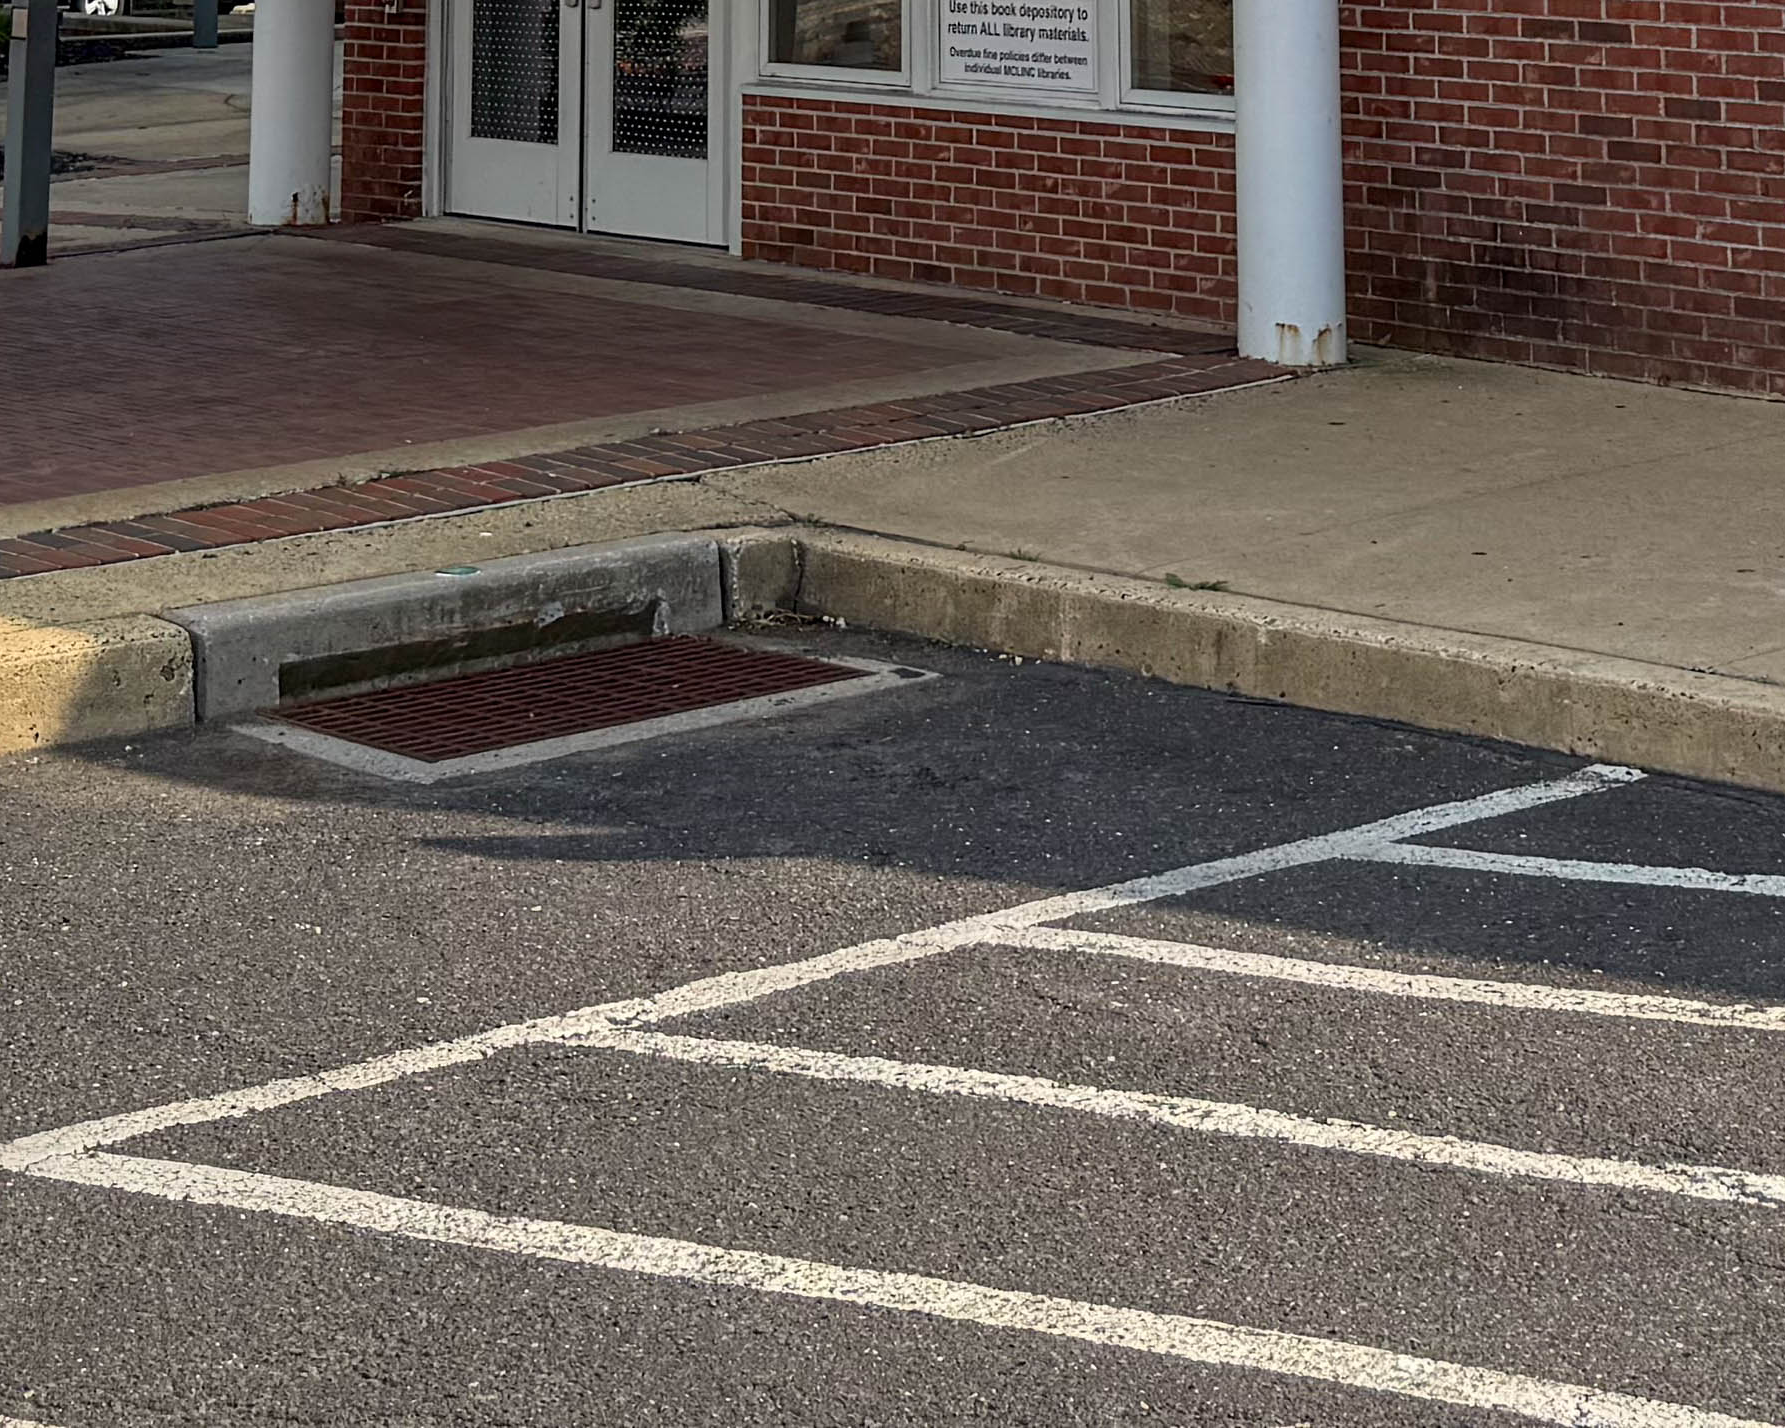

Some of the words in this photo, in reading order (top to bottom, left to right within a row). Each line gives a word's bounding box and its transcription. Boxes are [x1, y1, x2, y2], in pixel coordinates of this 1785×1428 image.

[949, 0, 968, 14] Use
[970, 1, 989, 15] this
[991, 2, 1016, 16] book
[1019, 3, 1075, 24] depository
[1077, 6, 1089, 21] to
[948, 22, 978, 35] return
[980, 22, 1001, 37] ALL
[1003, 24, 1036, 43] library
[950, 46, 982, 59] Overdue
[999, 51, 1030, 63] policies
[1054, 54, 1088, 66] between
